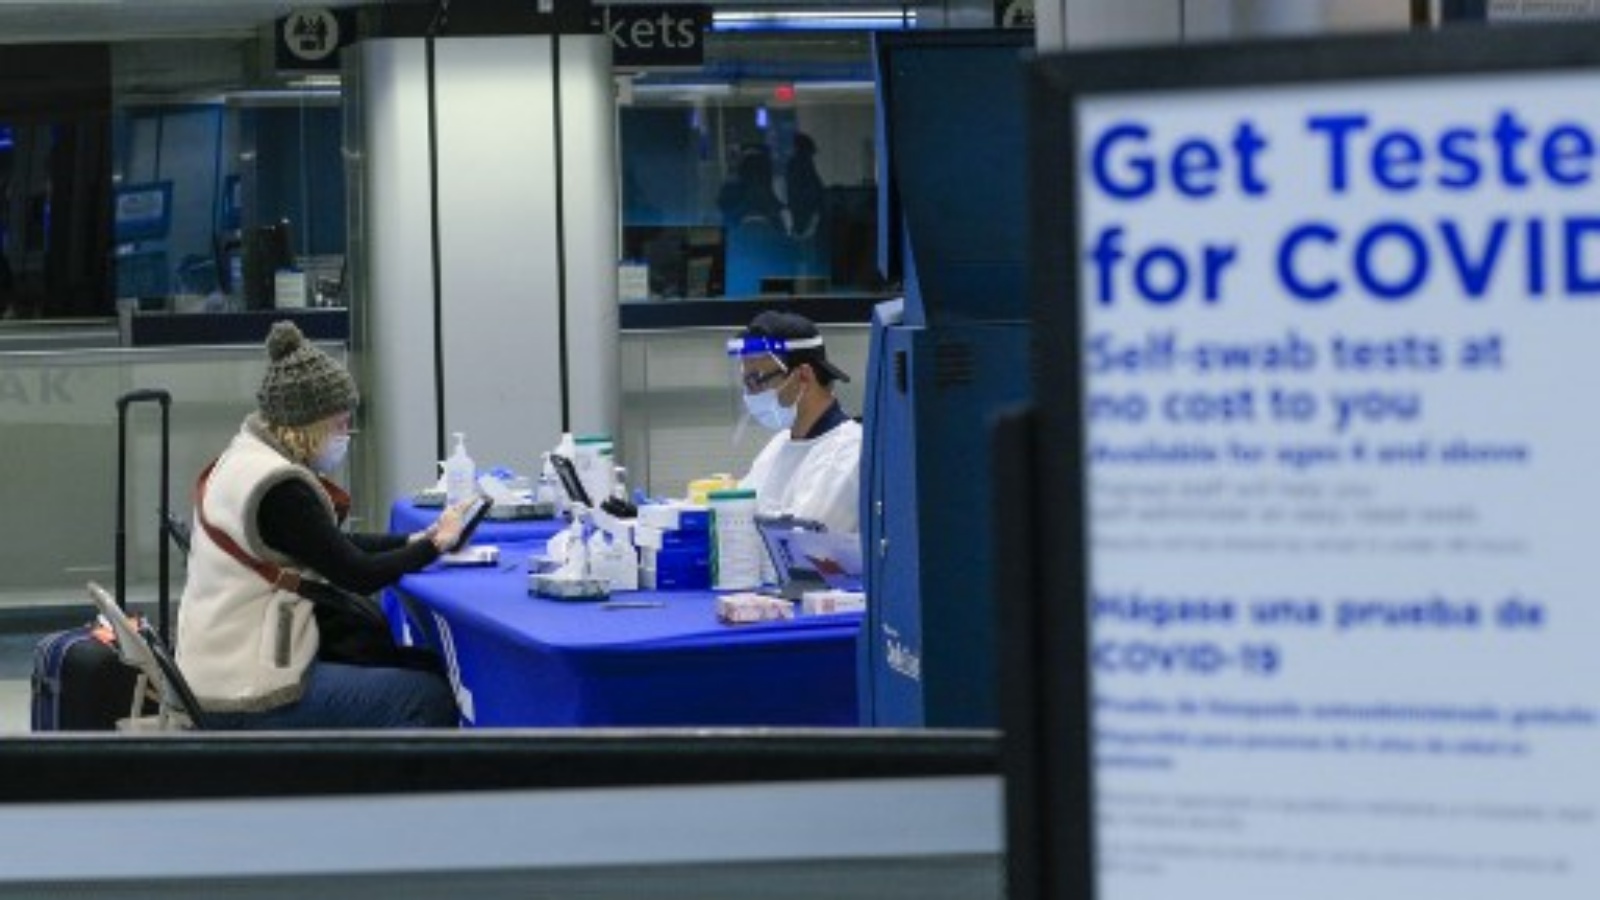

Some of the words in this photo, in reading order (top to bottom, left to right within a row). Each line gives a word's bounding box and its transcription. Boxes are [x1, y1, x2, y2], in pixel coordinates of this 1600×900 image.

[591, 9, 696, 48] kets
[1091, 120, 1268, 200] Get
[1307, 110, 1597, 192] Teste
[1091, 225, 1236, 304] for
[1088, 333, 1317, 371] Self-swab
[1332, 335, 1443, 370] tests
[1460, 334, 1503, 370] at
[1089, 393, 1148, 421] no
[1163, 388, 1255, 421] cost
[1271, 388, 1317, 421] to
[1332, 393, 1421, 433] you
[1251, 601, 1321, 626] una
[1334, 597, 1480, 634] prueba
[1496, 597, 1544, 629] de
